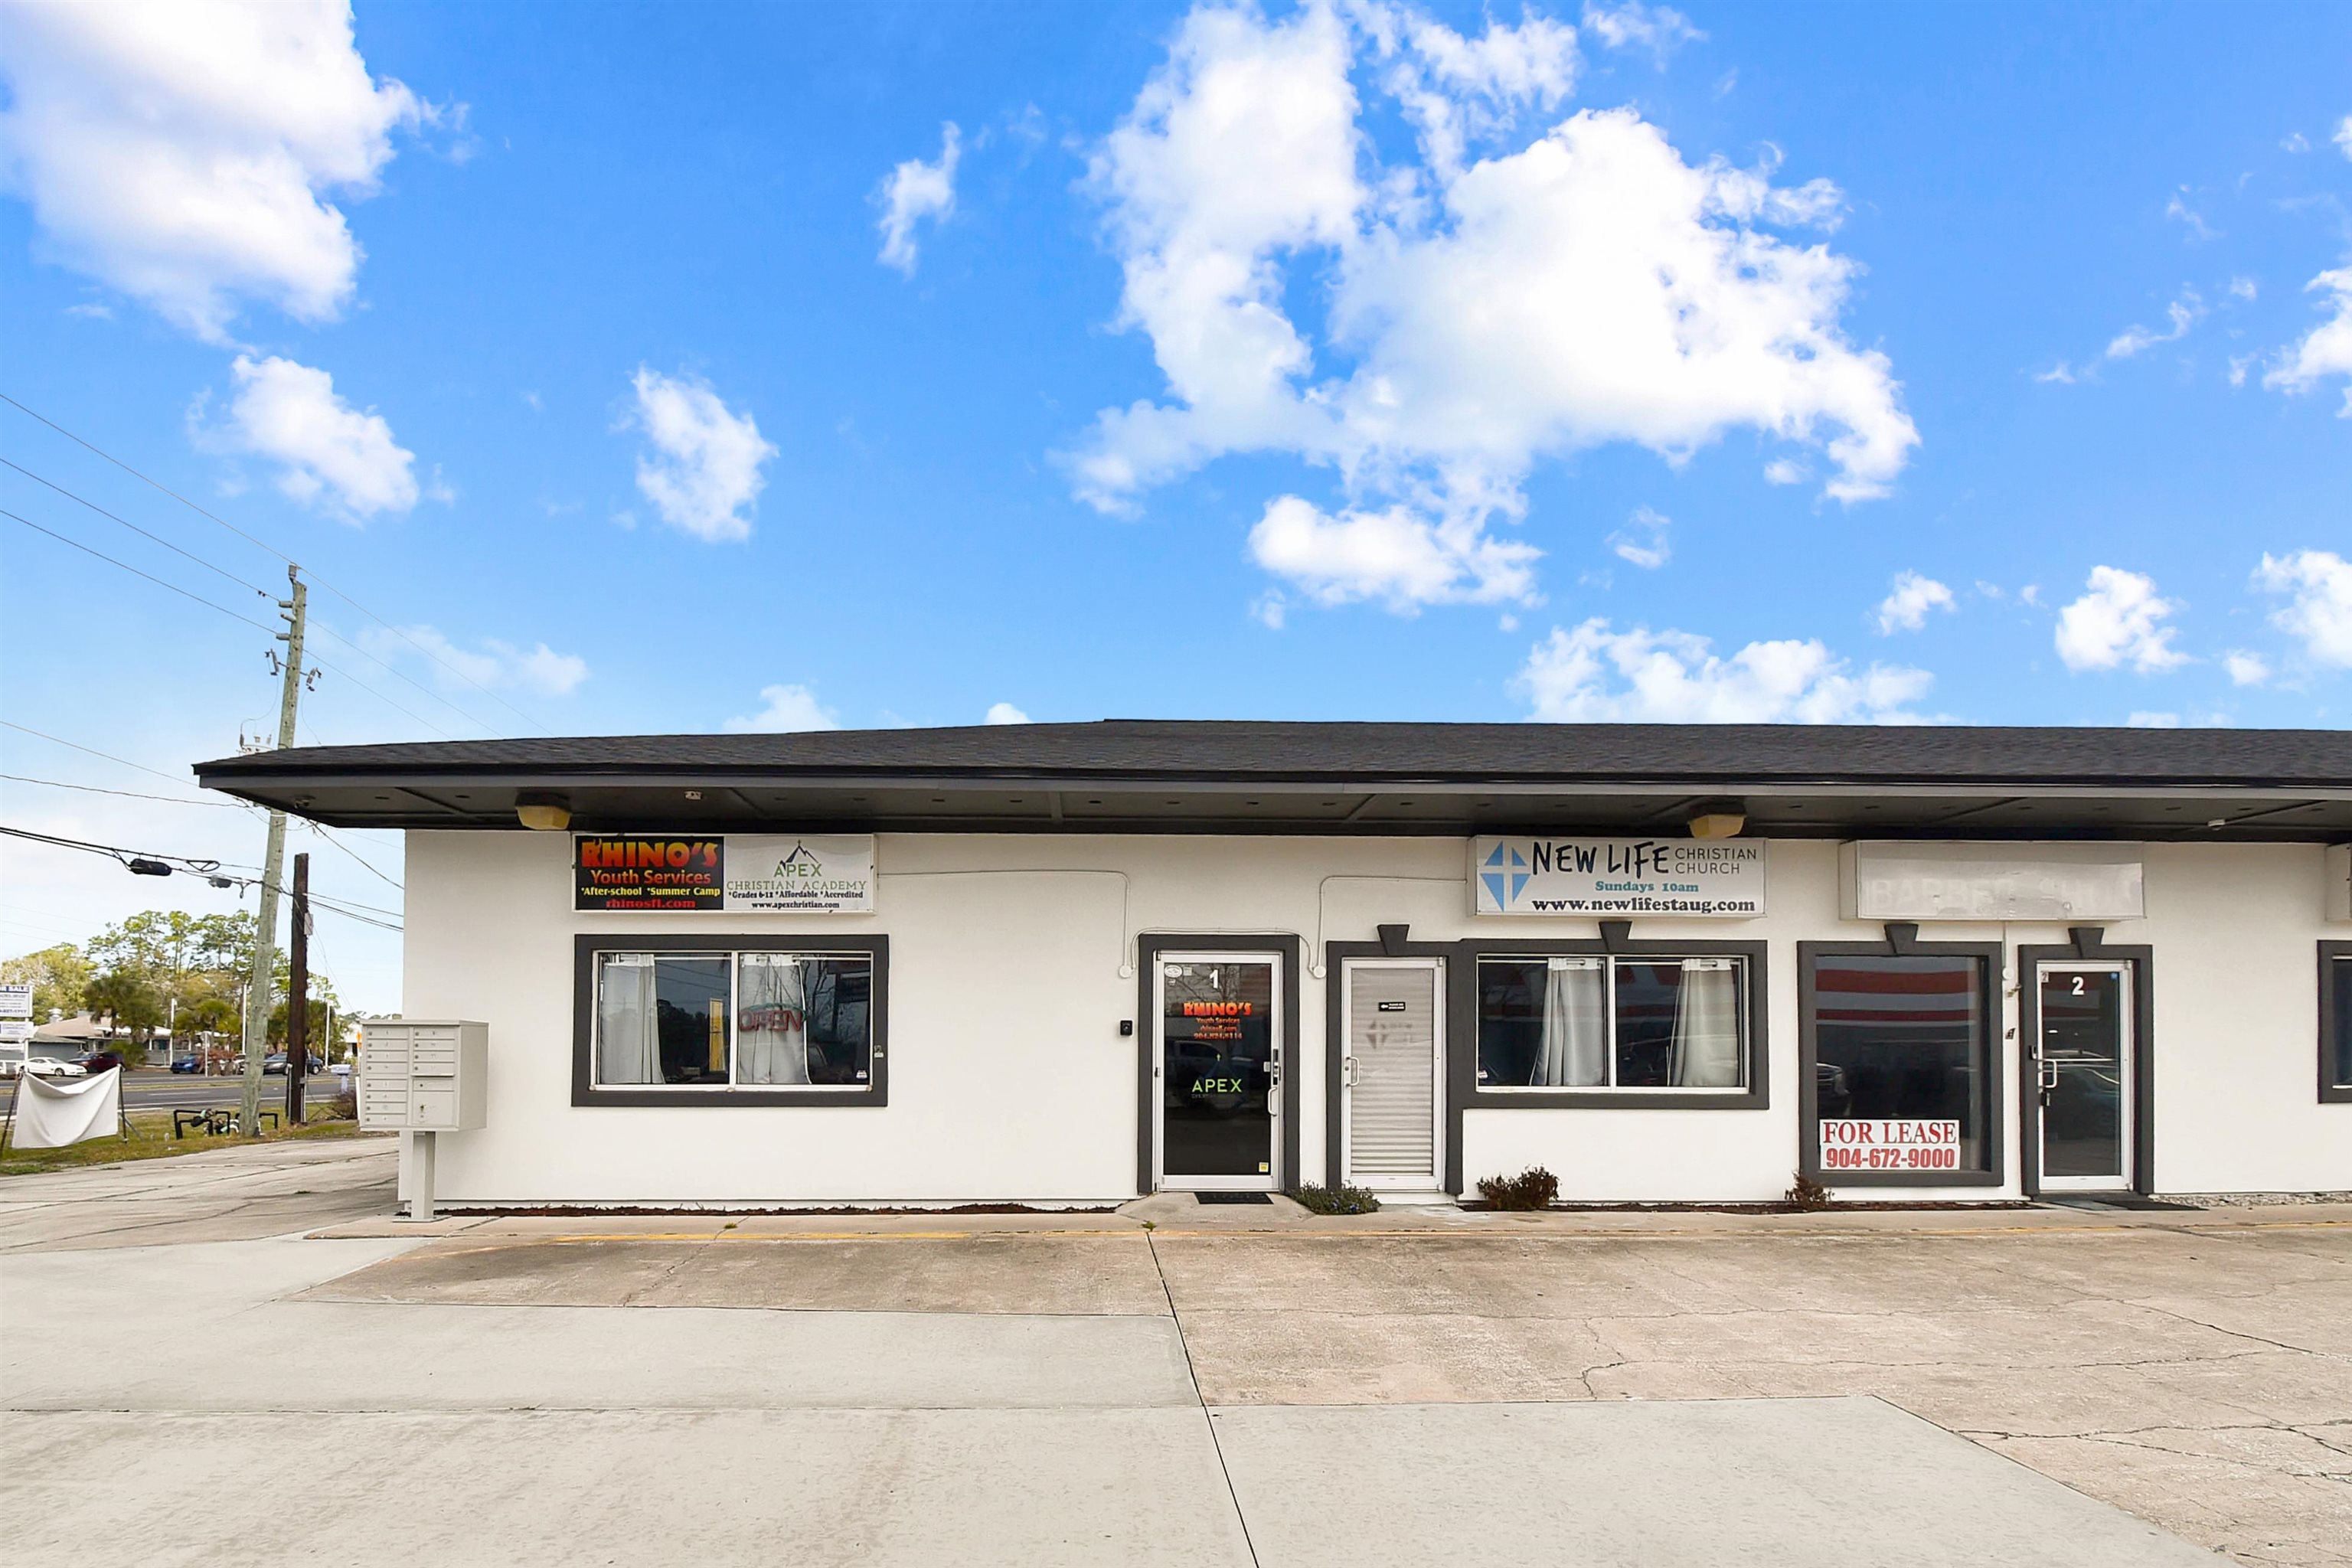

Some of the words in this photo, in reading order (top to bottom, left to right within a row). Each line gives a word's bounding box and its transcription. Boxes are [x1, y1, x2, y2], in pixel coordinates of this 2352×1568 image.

[581, 838, 718, 867] RHINO'S
[1532, 841, 1596, 876] NEW
[1608, 841, 1670, 879] LIFE
[1674, 848, 1756, 861] CHRISTIAN
[773, 863, 822, 877] APEX
[1674, 862, 1740, 874] CHURCH
[590, 869, 639, 884] Youth
[643, 869, 711, 884] Services
[693, 887, 720, 897] Camp
[727, 880, 795, 890] CHRISTIAN
[803, 880, 867, 890] ACADEMY
[1595, 880, 1655, 893] Sundays
[1661, 882, 1700, 893] 10am
[751, 900, 840, 910] www.apexchristian.com
[1532, 897, 1756, 913] www.newlifestaug.com
[1210, 969, 1219, 988] 1
[2072, 976, 2084, 995] 2
[1183, 1001, 1253, 1016] RHINO'S
[740, 1009, 802, 1032] OPEN
[1191, 1078, 1242, 1093] APEX
[1823, 1122, 1874, 1144] FOR
[1882, 1122, 1956, 1144] LEASE
[1826, 1148, 1955, 1168] 904-672-9000
